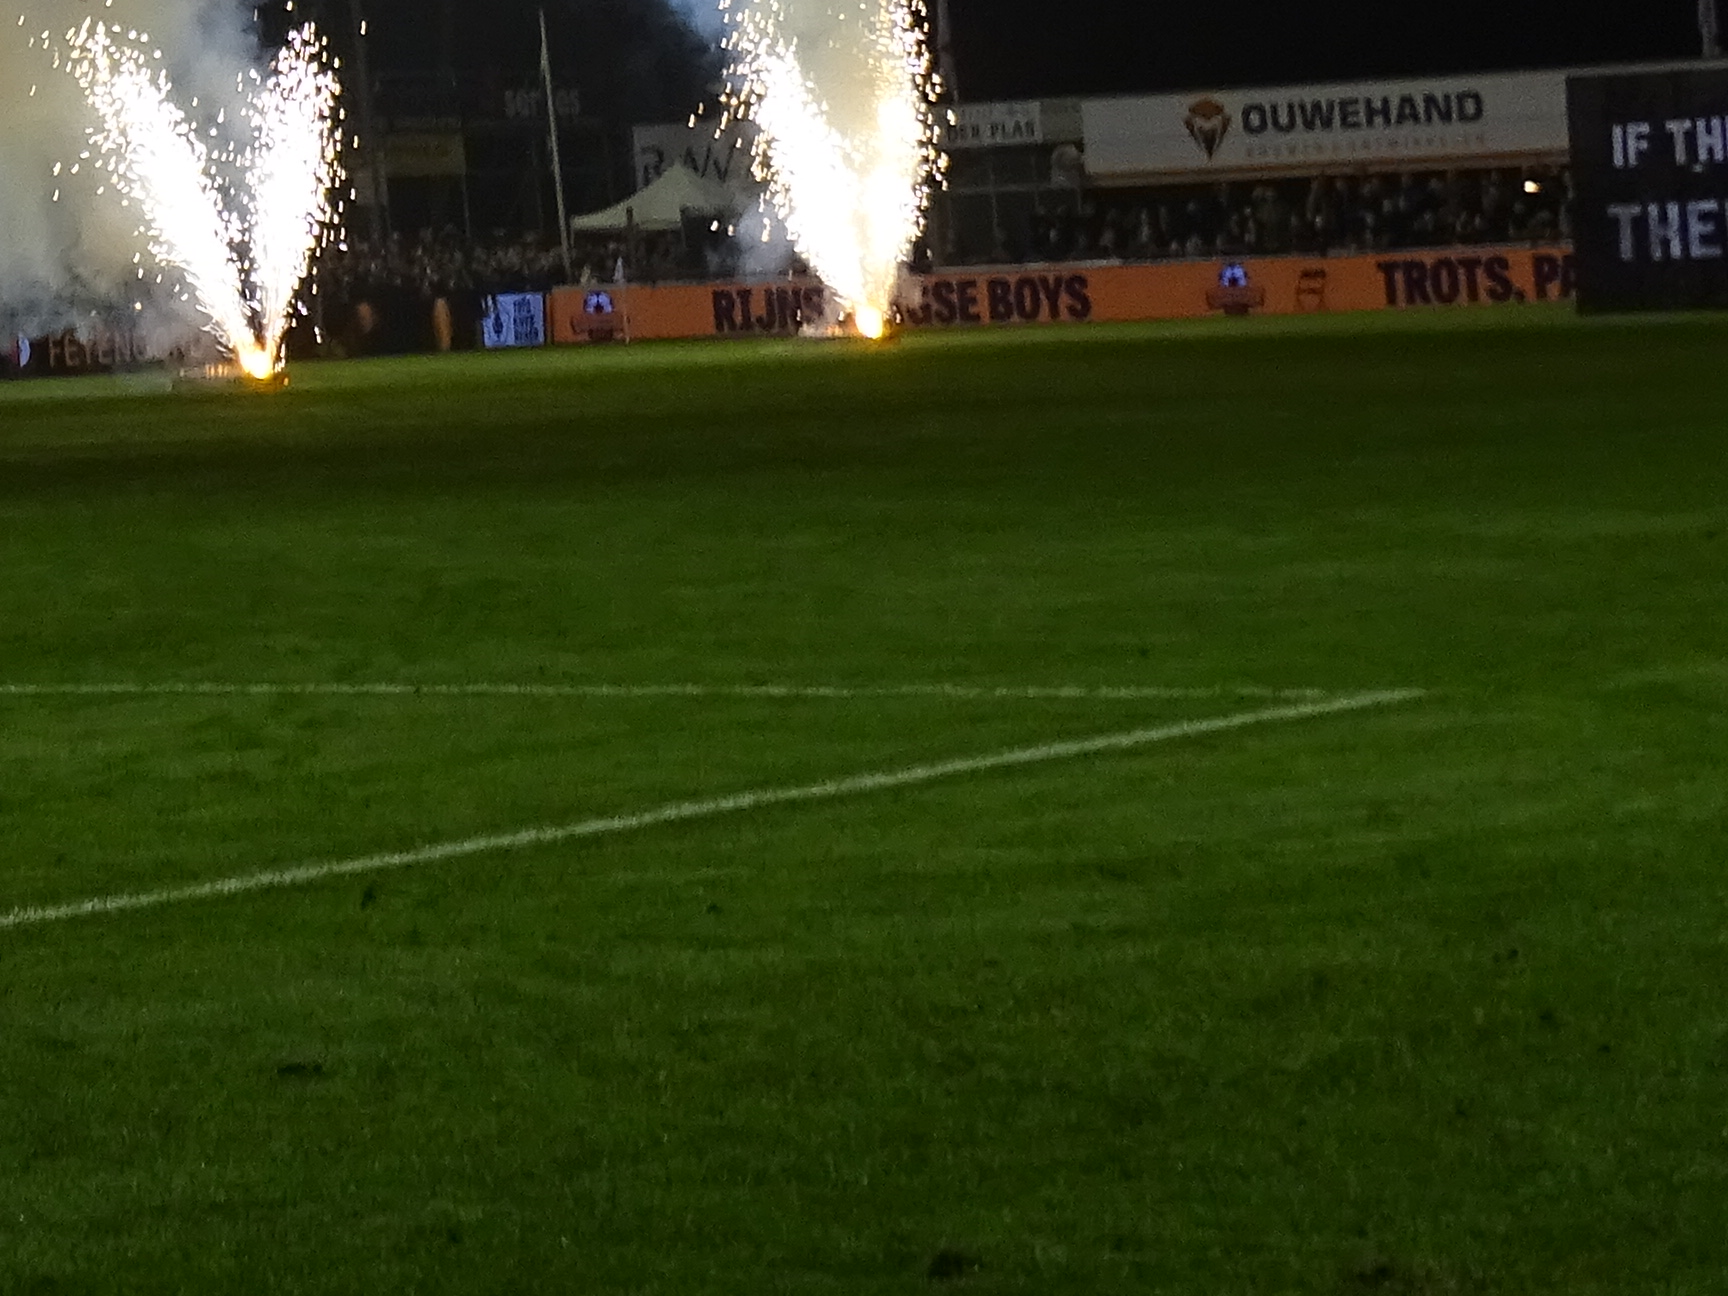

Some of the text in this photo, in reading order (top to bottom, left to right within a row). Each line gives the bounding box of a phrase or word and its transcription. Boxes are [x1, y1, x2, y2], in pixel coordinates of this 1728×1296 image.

[1241, 89, 1485, 136] OUWEHAND
[1611, 115, 1728, 169] IF TH
[1605, 197, 1728, 263] THE
[987, 273, 1094, 322] BOYS
